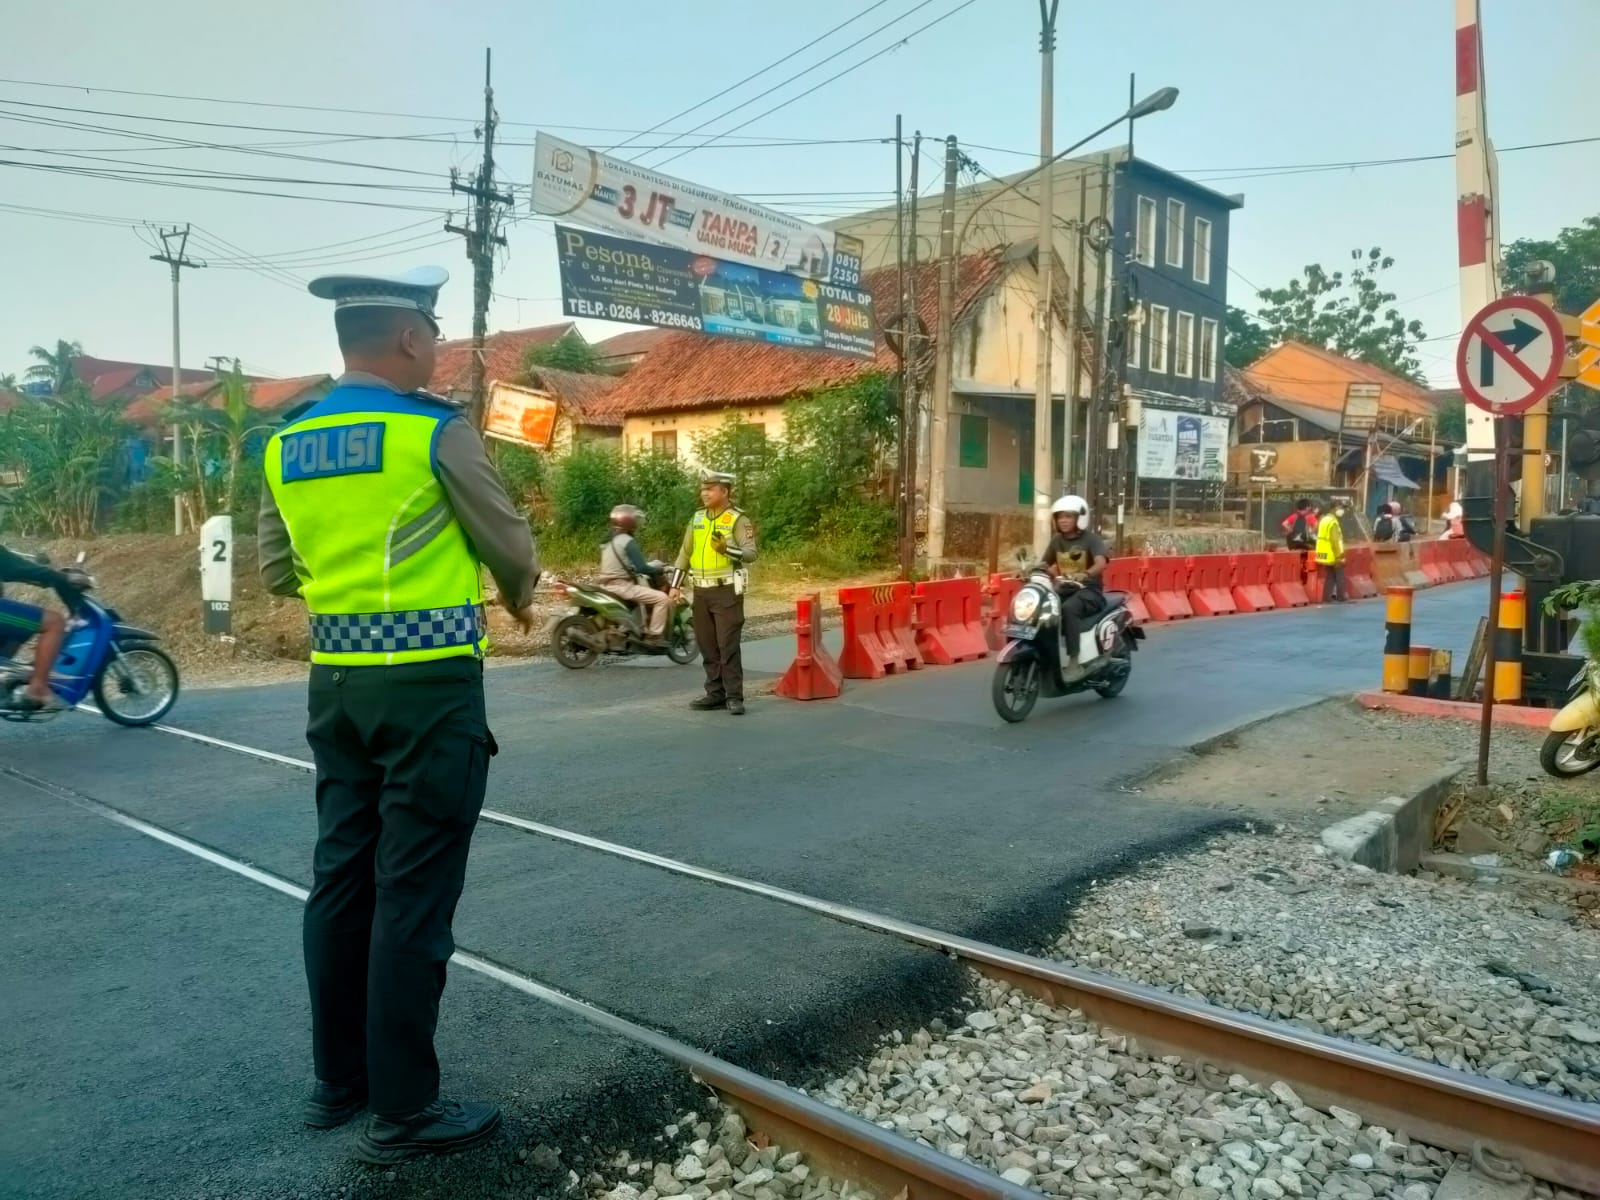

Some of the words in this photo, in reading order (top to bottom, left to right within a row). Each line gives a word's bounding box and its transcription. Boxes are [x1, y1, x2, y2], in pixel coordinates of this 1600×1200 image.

[537, 171, 584, 191] BATUMAS
[603, 161, 631, 176] LOKASI
[633, 171, 670, 187] STRATEGIS
[672, 182, 680, 191] DI
[722, 198, 748, 212] TENGAH
[749, 207, 764, 219] KOTA
[765, 211, 802, 231] PURWAKARTA
[618, 185, 637, 219] 3
[640, 191, 676, 230] JT
[702, 210, 758, 246] TANPA
[562, 231, 655, 271] Pesona
[697, 230, 726, 249] UANG
[727, 239, 757, 259] MUKA
[769, 239, 781, 258] 2
[836, 254, 860, 270] 0812
[832, 267, 859, 285] 2350
[819, 285, 855, 303] TOTAL
[858, 293, 872, 306] DP
[568, 298, 606, 316] TELP.
[609, 303, 641, 321] 0264
[651, 310, 702, 330] 8226643
[844, 306, 869, 329] Juta
[283, 426, 379, 477] POLISI
[212, 540, 227, 562] 2
